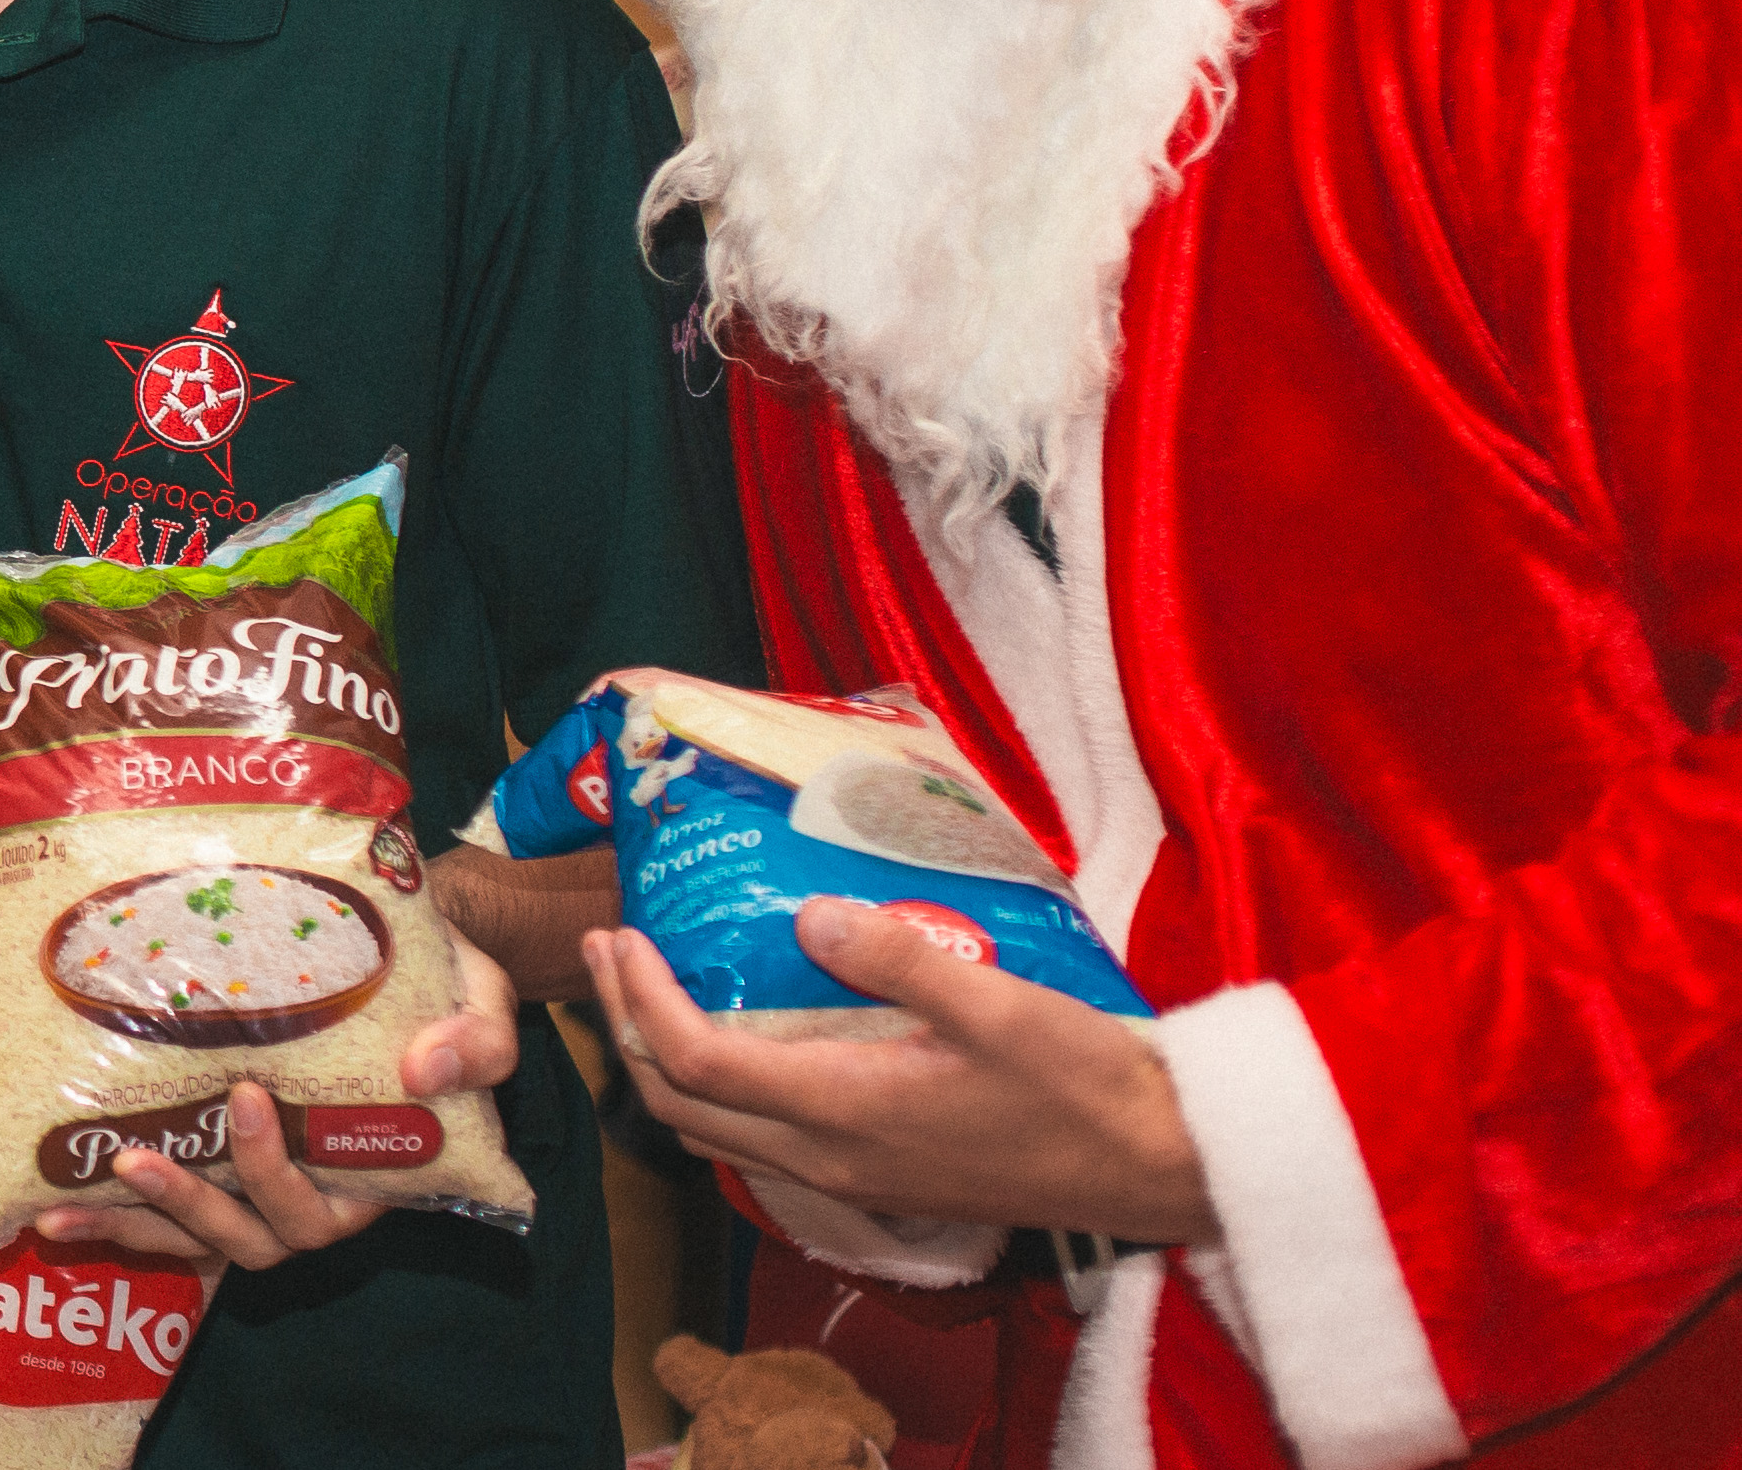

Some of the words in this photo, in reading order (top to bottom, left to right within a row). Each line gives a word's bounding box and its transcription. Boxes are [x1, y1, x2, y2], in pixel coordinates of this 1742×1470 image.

[77, 459, 257, 523] Operação
[54, 498, 215, 568] NATA
[233, 616, 403, 737] Fino
[121, 754, 303, 791] BRANCO
[37, 834, 50, 861] 2
[53, 839, 67, 863] kg
[655, 813, 726, 853] Arroz
[639, 829, 763, 894] Branco
[93, 1086, 148, 1109] ARROZ
[149, 1073, 214, 1102] POLIDO
[281, 1077, 321, 1097] FINO
[335, 1077, 373, 1097] TIPO
[378, 1078, 386, 1097] 1
[324, 1135, 423, 1153] BRANCO
[20, 1352, 65, 1372] desde
[70, 1359, 106, 1379] 1968
